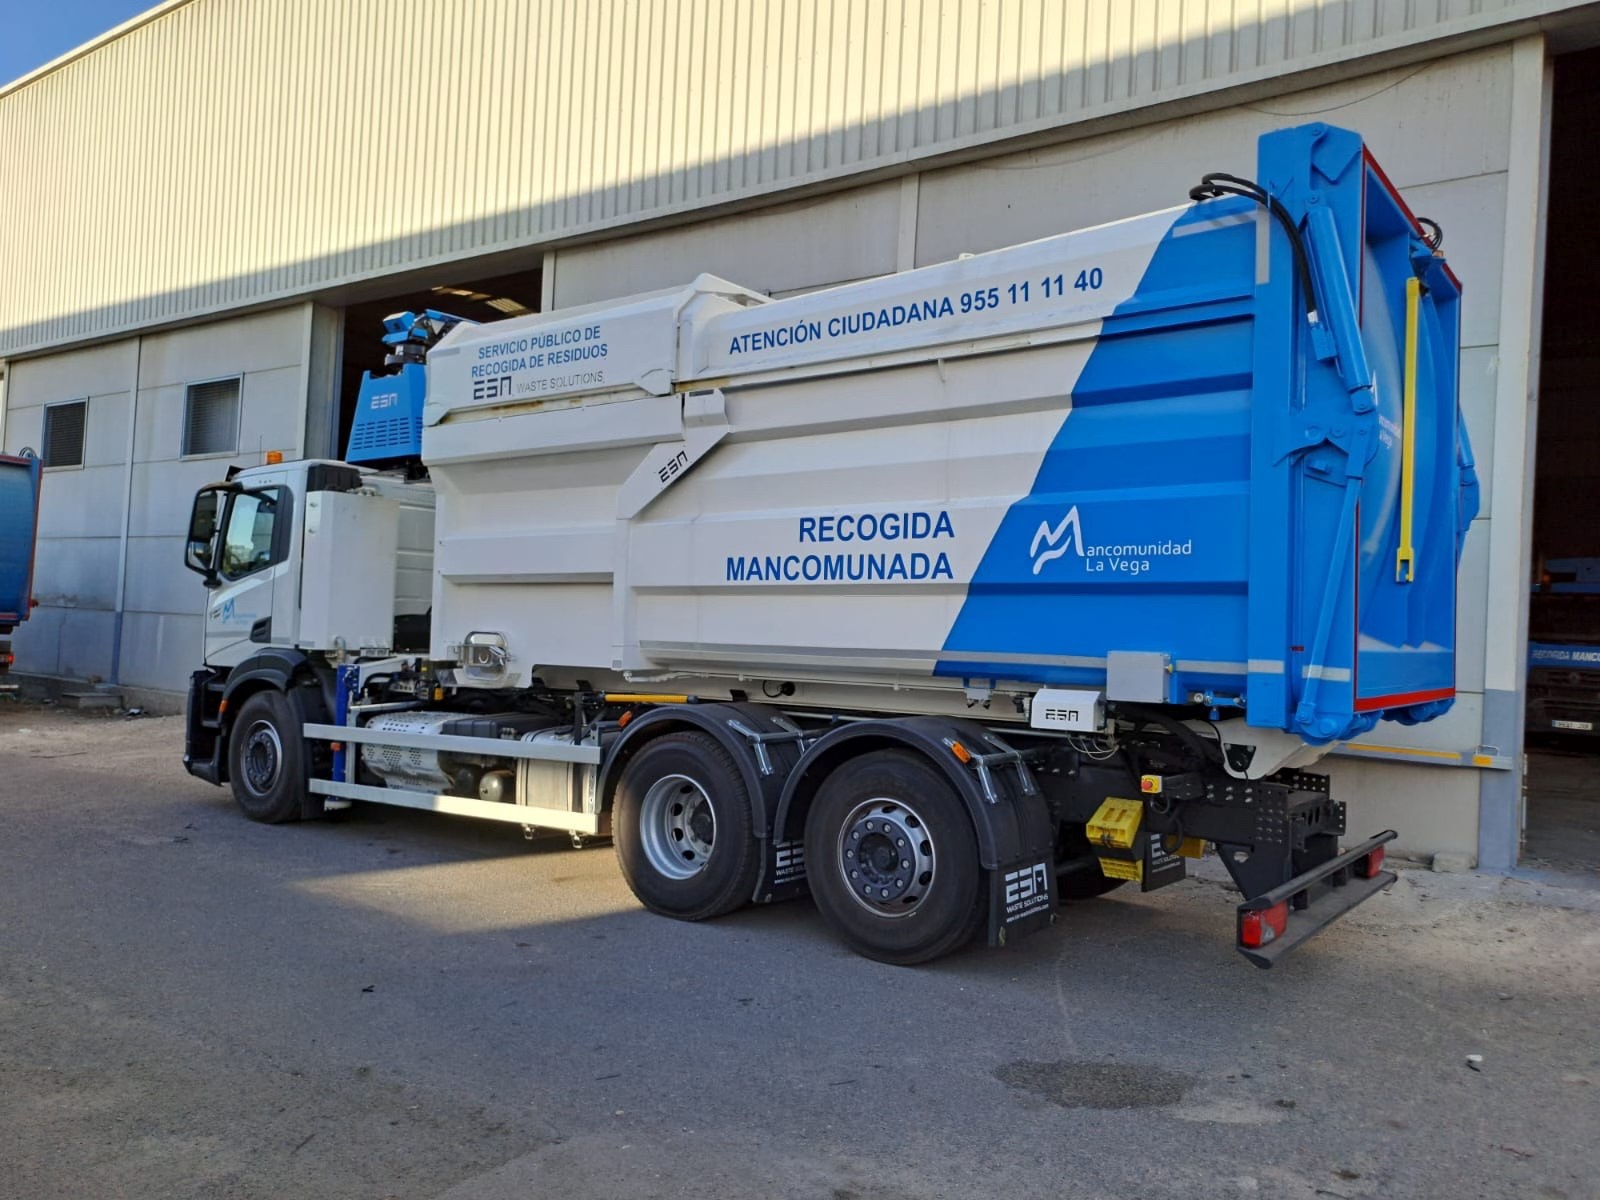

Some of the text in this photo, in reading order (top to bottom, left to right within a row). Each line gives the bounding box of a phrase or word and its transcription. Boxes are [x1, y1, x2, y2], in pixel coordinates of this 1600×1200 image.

[729, 267, 1103, 354] ATENCIÓN CIUDADANA 955 11 11 40
[478, 325, 601, 360] SERVICIO PÚBLICO DE
[471, 343, 608, 378] RECOGIDA DE RESIDUOS
[517, 380, 547, 393] WASTE
[550, 371, 603, 389] SOLUTIONS
[800, 511, 954, 543] RECOGIDA
[726, 552, 953, 582] MANCOMUNADA
[1086, 558, 1150, 576] La Vega
